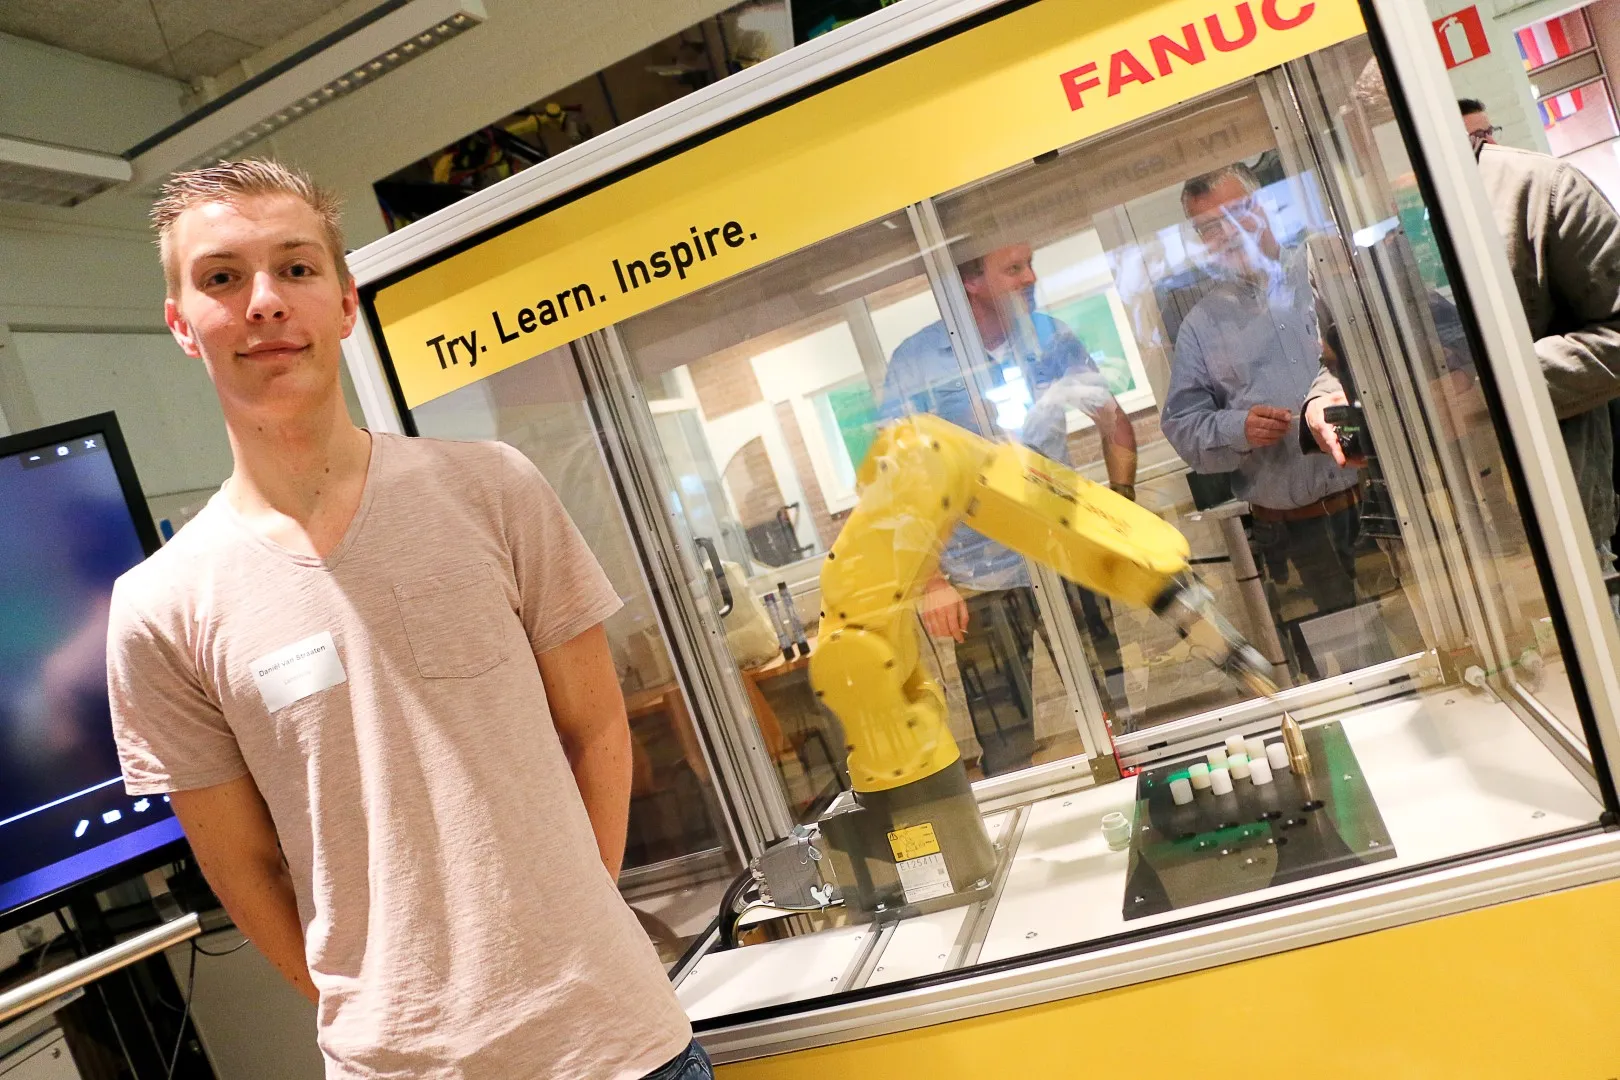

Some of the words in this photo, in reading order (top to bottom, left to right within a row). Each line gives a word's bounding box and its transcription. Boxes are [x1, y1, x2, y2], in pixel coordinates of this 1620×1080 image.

[1059, 0, 1316, 112] FANUC
[426, 330, 487, 370] Try.
[492, 283, 606, 345] Learn.
[612, 220, 757, 293] Inspire.
[281, 657, 295, 667] van
[296, 645, 326, 660] Straaten
